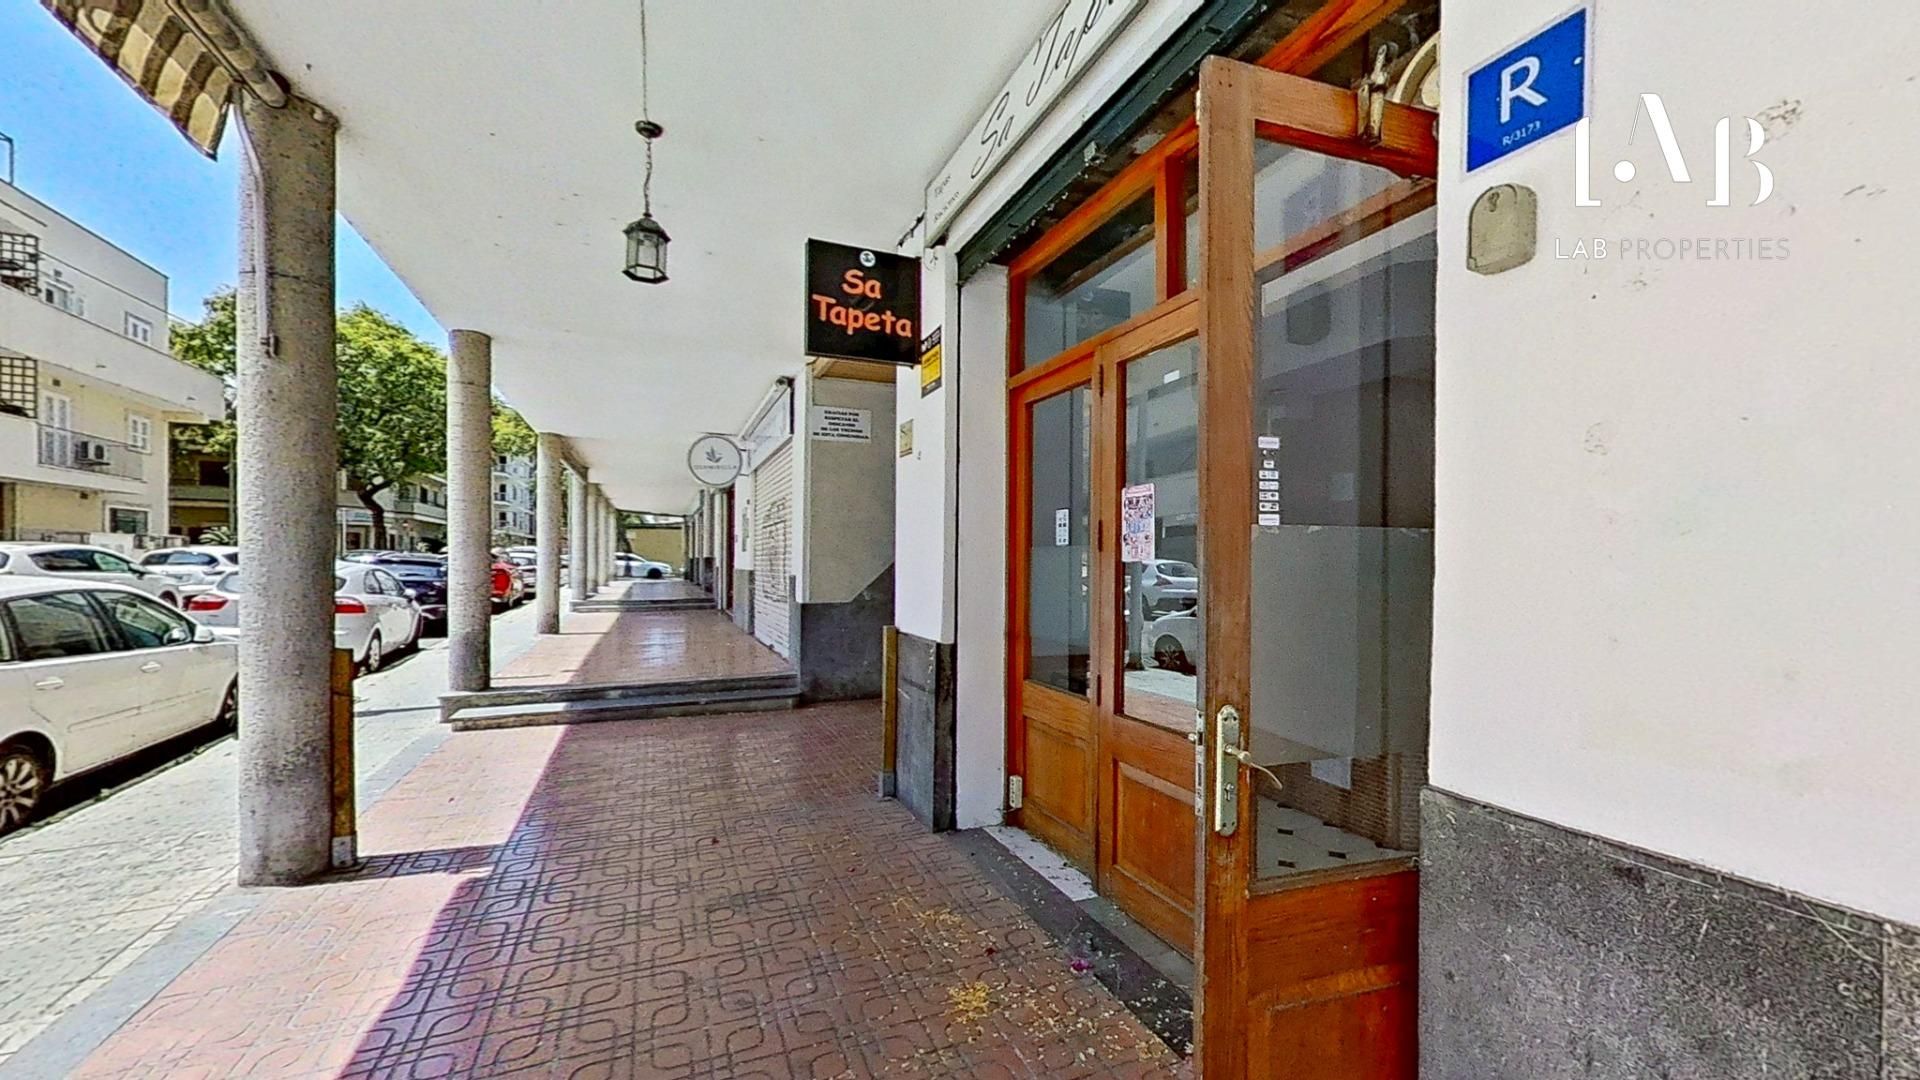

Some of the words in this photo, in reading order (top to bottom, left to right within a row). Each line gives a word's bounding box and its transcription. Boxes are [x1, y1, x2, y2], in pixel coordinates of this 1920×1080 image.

[1500, 56, 1548, 124] R
[971, 91, 1015, 179] Sa
[1502, 120, 1541, 146] R/3173
[842, 269, 882, 299] Sa
[812, 293, 912, 338] Tapeta
